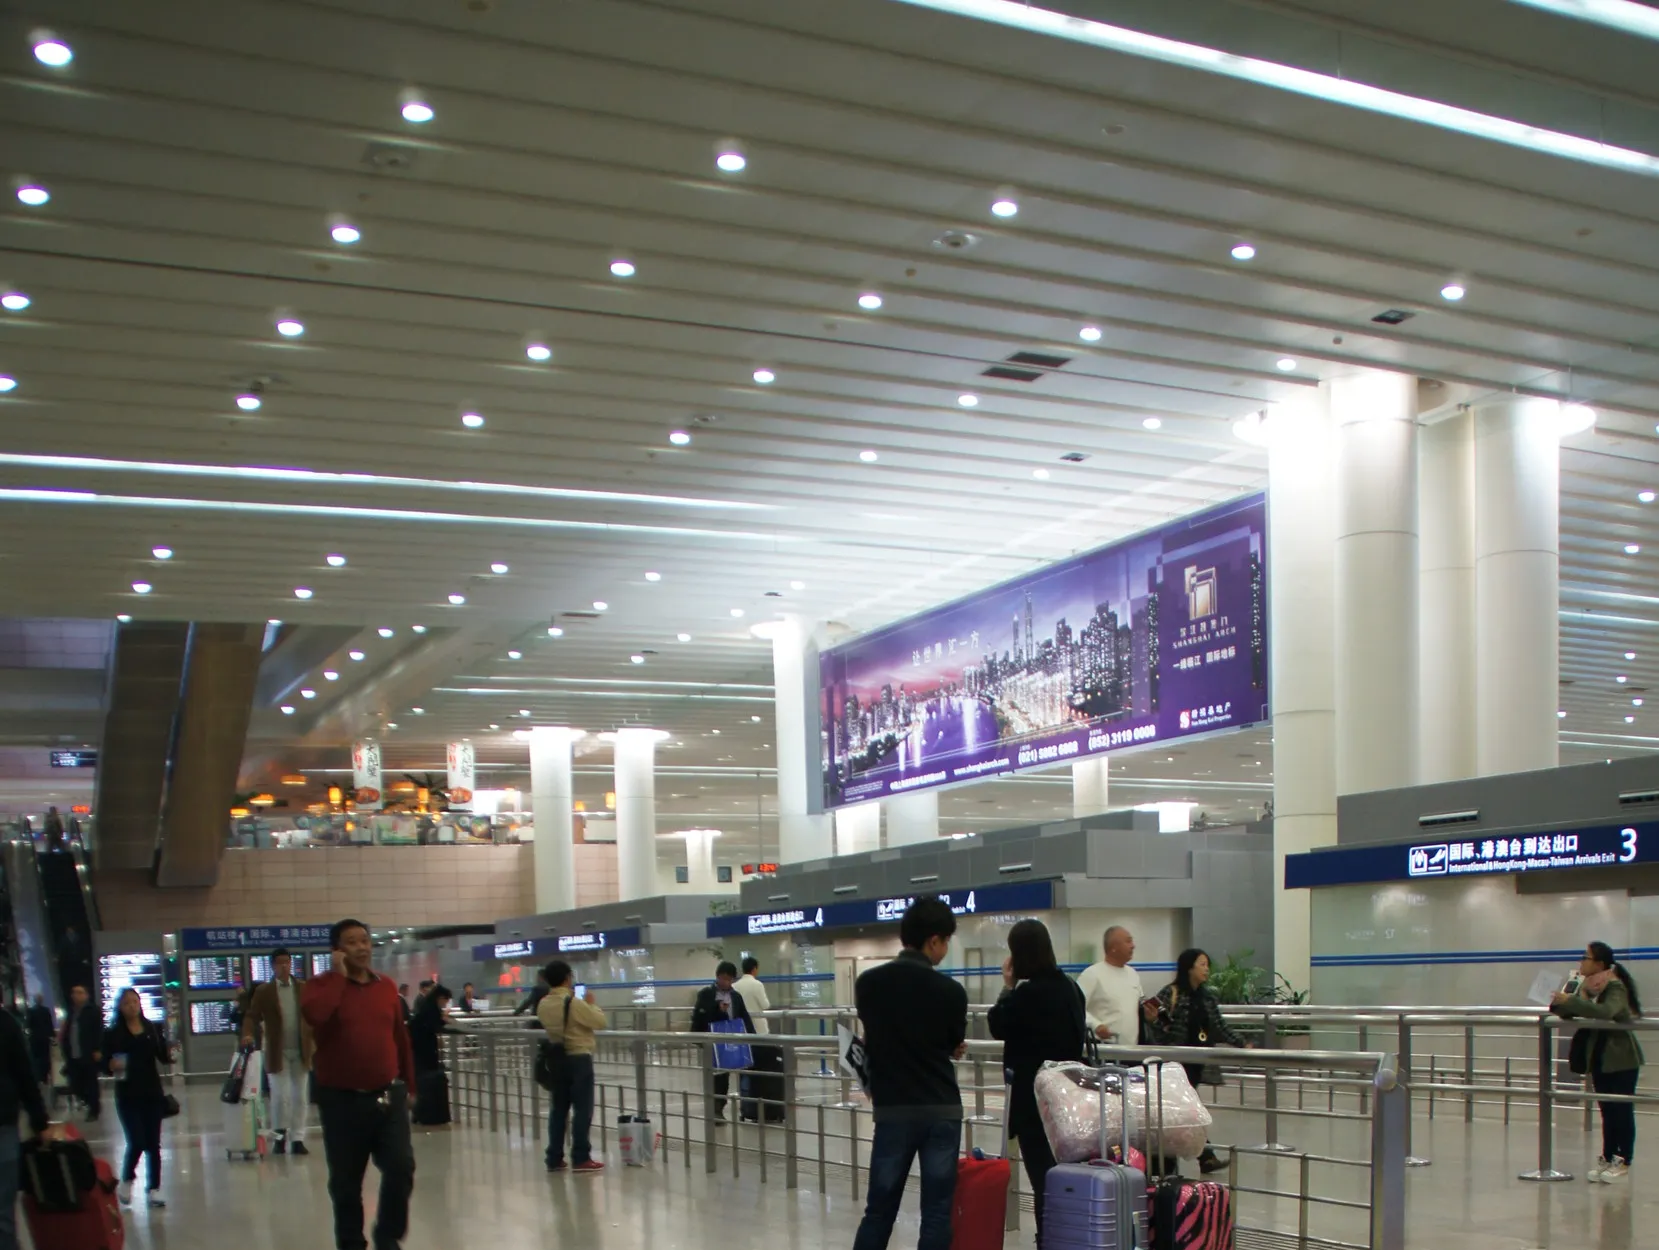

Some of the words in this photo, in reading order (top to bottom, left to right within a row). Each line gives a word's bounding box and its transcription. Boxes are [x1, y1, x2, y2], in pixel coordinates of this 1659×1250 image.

[1449, 834, 1579, 861] 国际、港澳台到达出口
[1619, 827, 1638, 862] 3
[1575, 853, 1601, 865] Arrivals
[1601, 853, 1616, 863] Exit
[966, 890, 976, 913] 4
[815, 907, 824, 927] 4
